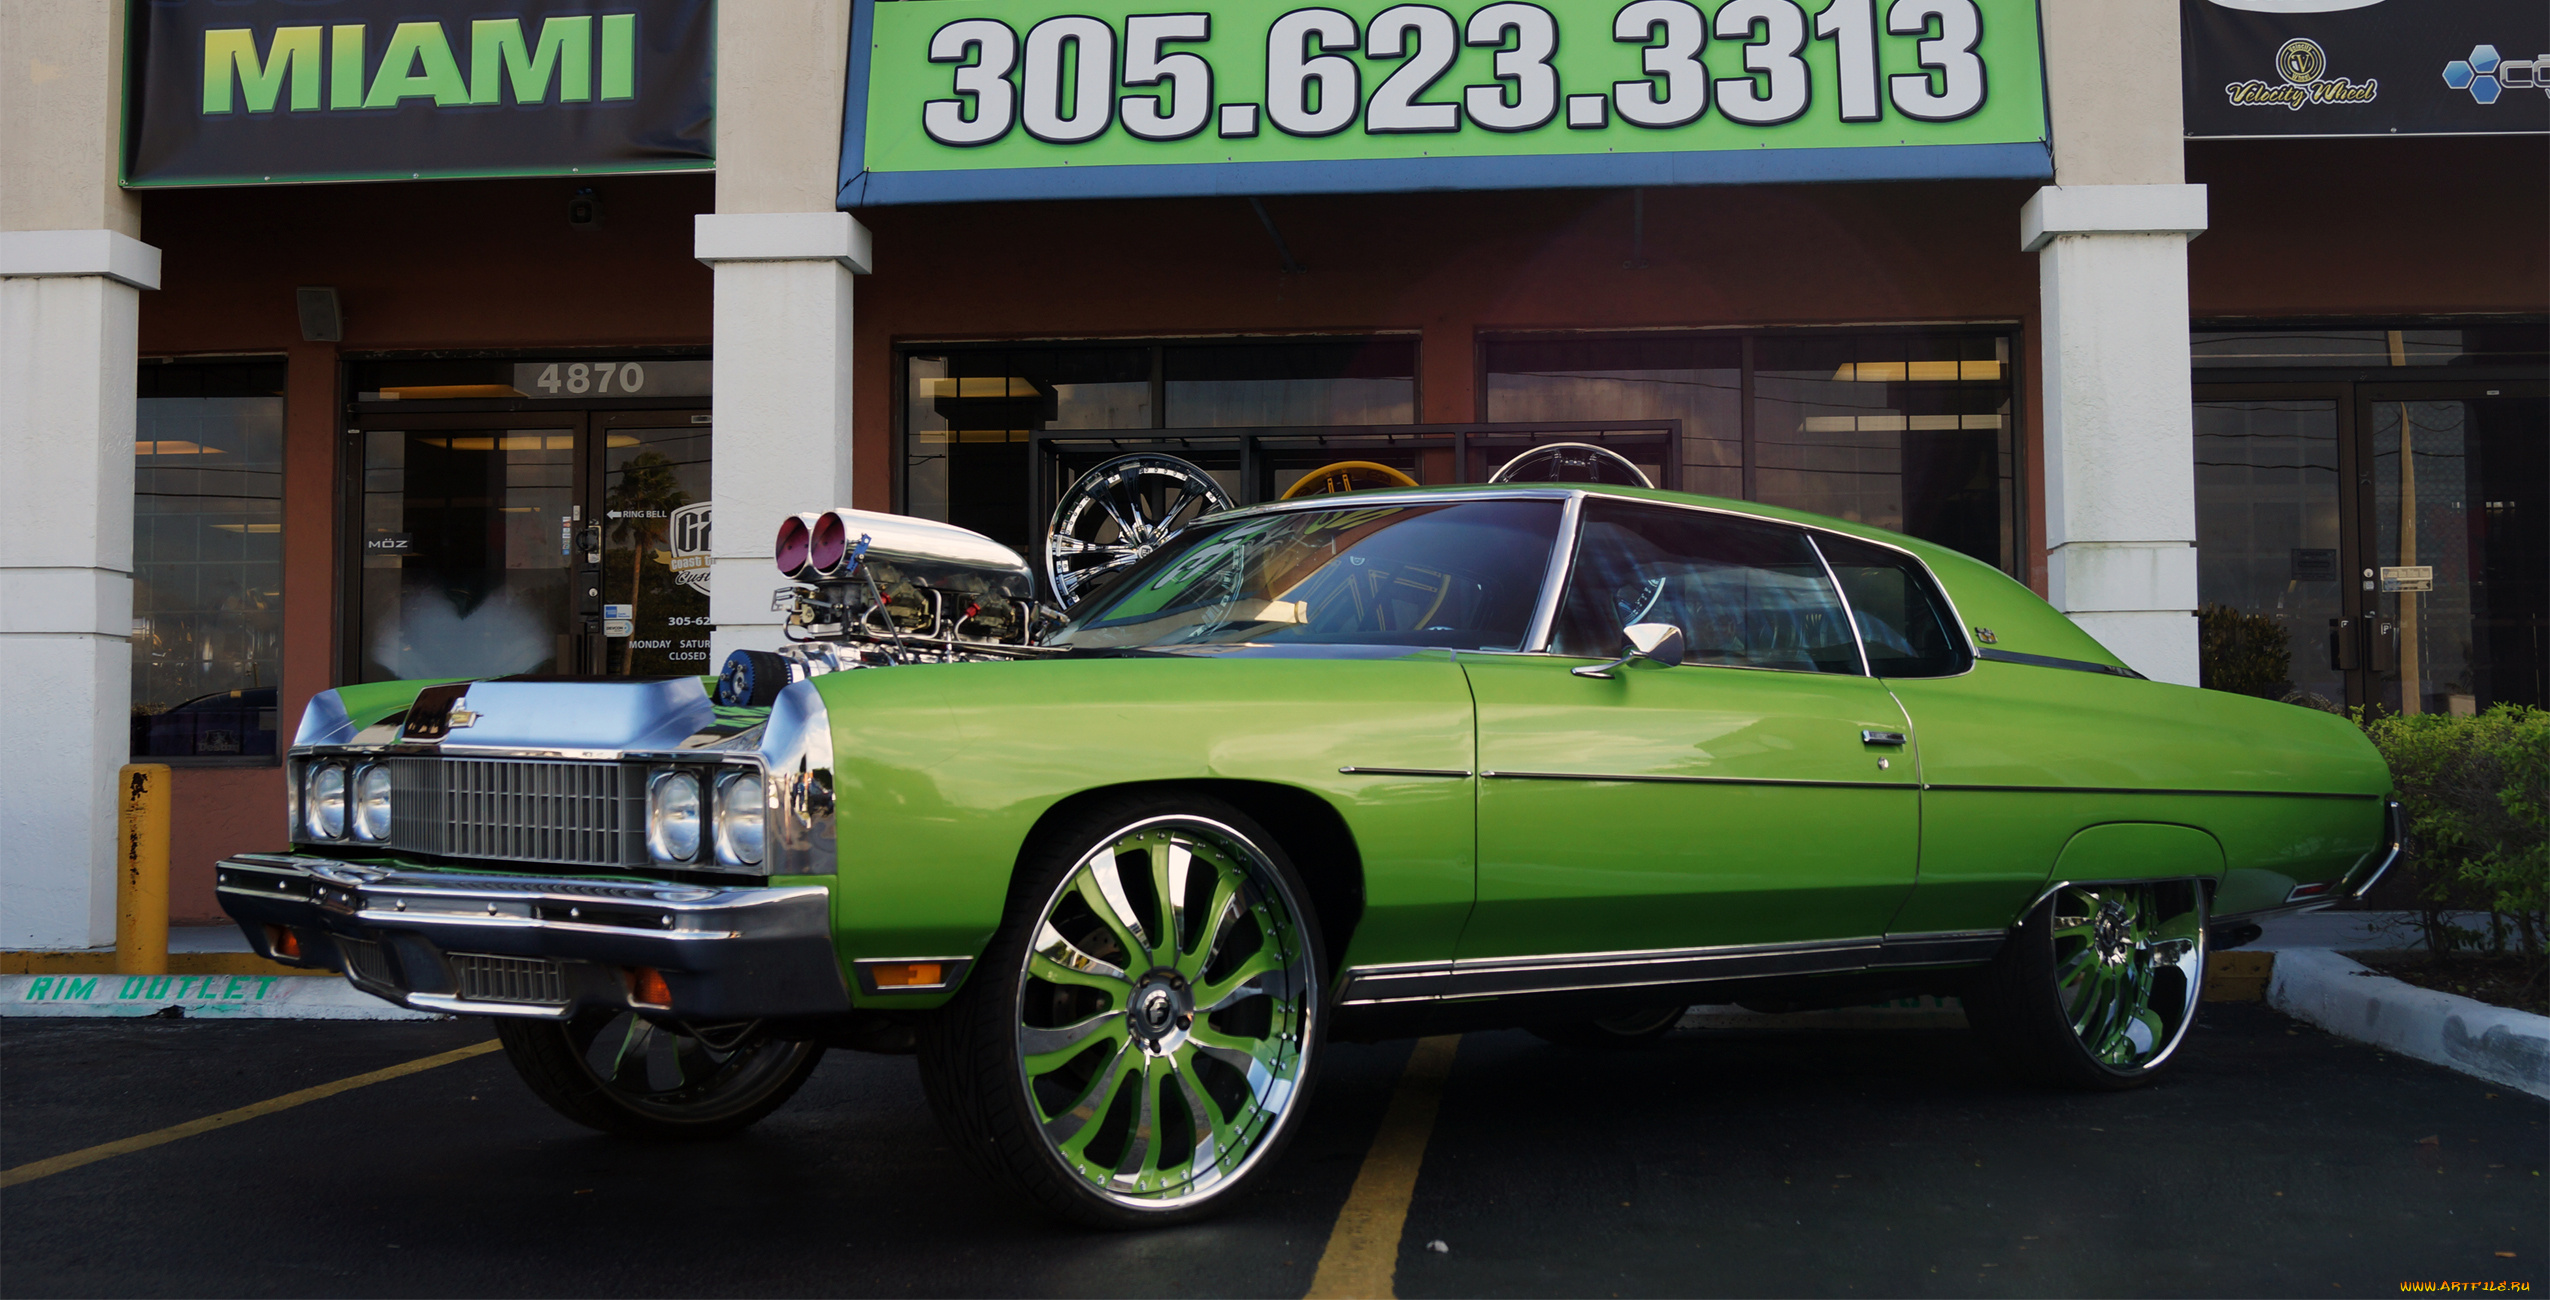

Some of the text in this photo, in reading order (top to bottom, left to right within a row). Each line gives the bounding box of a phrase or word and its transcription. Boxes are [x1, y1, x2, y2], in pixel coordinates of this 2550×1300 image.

[203, 14, 636, 115] MIAMI
[923, 0, 1988, 147] 305.623.3313
[2228, 80, 2376, 109] Velocity Wheel
[537, 362, 644, 394] 4870
[623, 510, 667, 518] RING BELL
[368, 538, 408, 548] MÖZ
[629, 640, 671, 649] MONDAY
[668, 652, 707, 661] CLOSED
[26, 976, 278, 1000] RIM OUTLET
